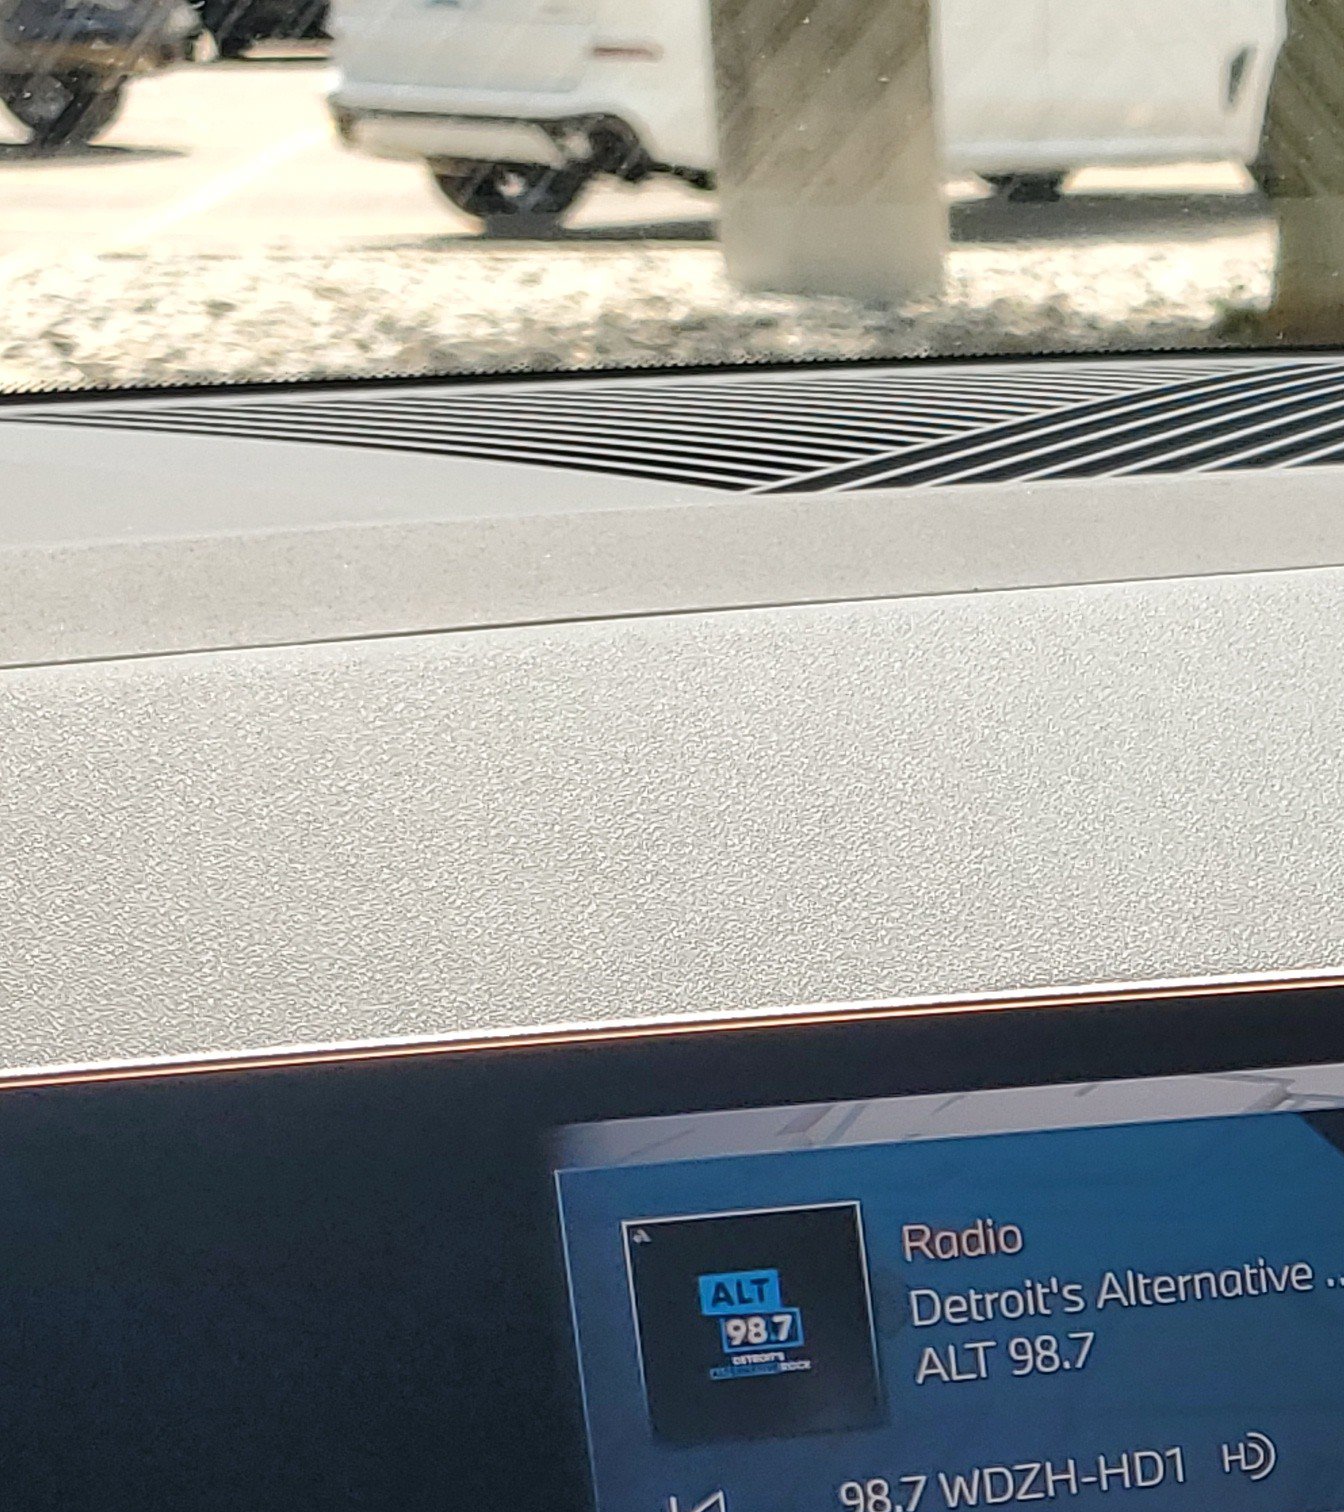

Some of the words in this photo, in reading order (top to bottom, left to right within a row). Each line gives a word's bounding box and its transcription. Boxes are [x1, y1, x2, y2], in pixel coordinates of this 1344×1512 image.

[901, 1219, 1024, 1262] Radio
[711, 1278, 769, 1307] ALT
[909, 1277, 1085, 1327] Detroit's
[1097, 1258, 1314, 1309] Alternative
[915, 1341, 997, 1384] ALT
[1008, 1332, 1095, 1376] 98.7
[938, 1447, 1184, 1509] WDZH-HD1
